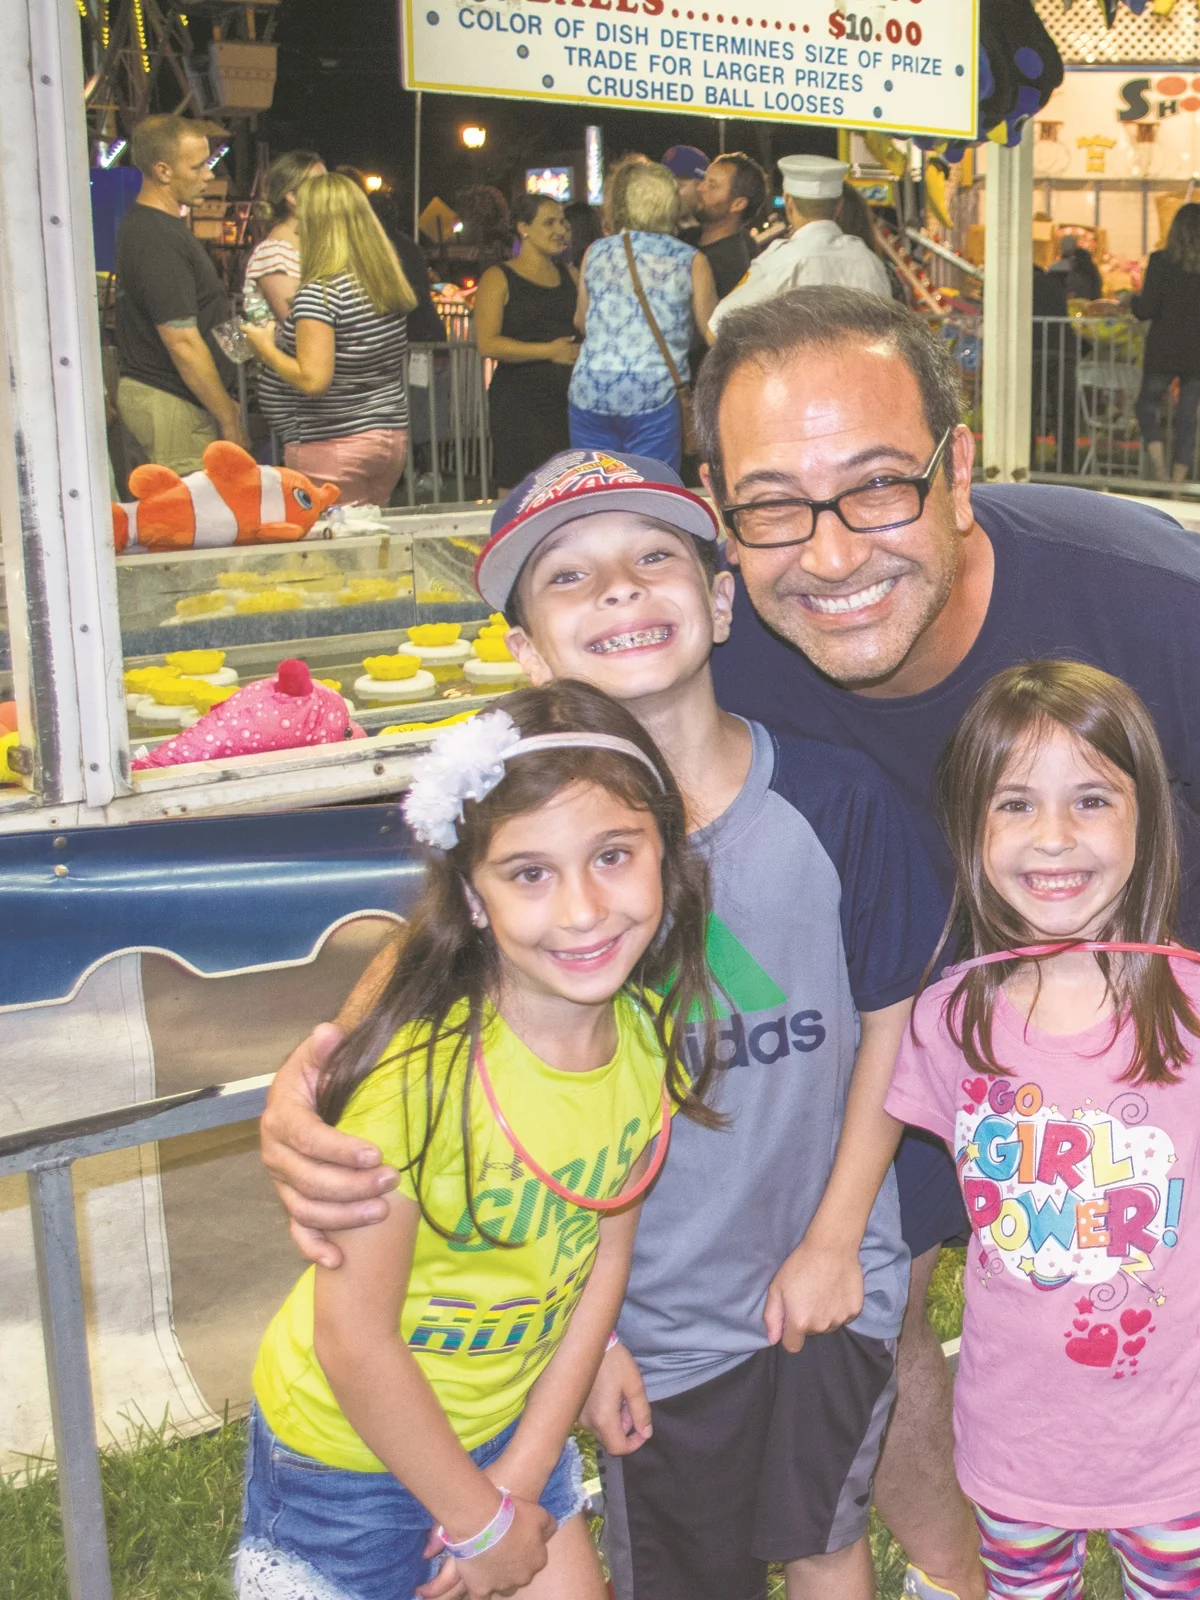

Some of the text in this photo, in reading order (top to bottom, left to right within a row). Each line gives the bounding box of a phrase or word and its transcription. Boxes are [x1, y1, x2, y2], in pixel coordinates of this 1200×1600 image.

[458, 7, 943, 76] COLOR OF DISH DETERMINES SIZE OF PRIZE
[828, 9, 922, 47] $10.00
[564, 46, 863, 93] TRADE FOR LARGER PRIZES
[587, 75, 844, 116] CRUSHED BALL LOOSES
[988, 1079, 1043, 1117] GO
[973, 1114, 1135, 1189] GIRL
[964, 1177, 1185, 1258] POWER!
